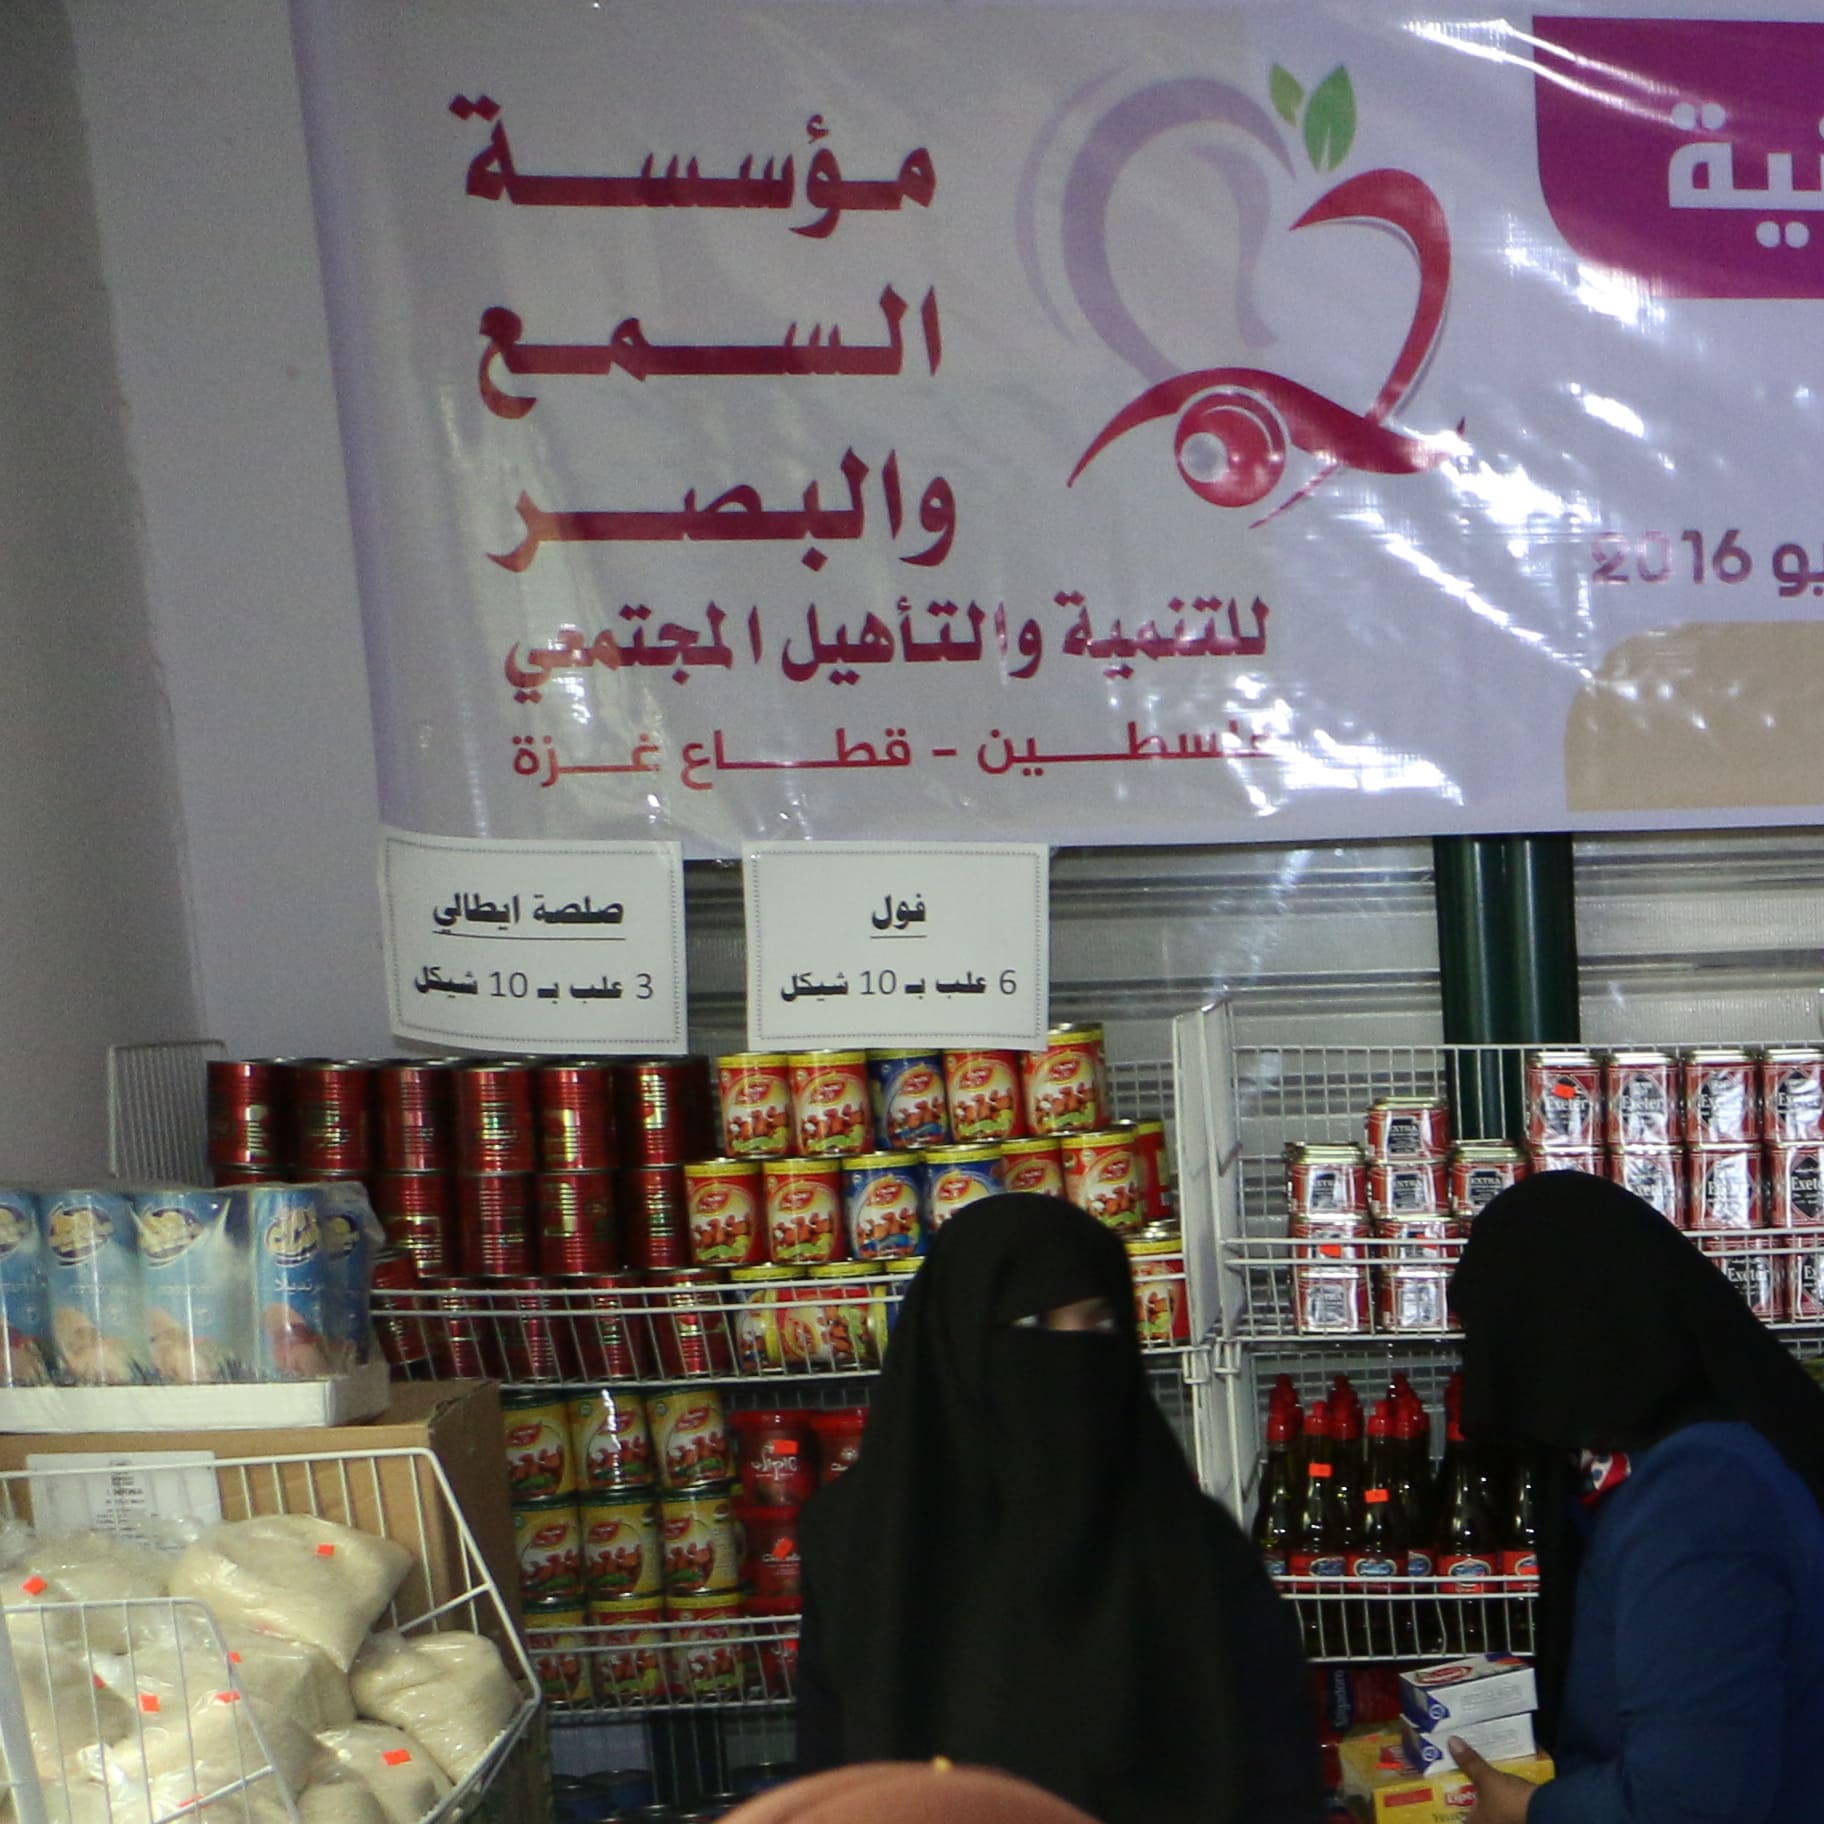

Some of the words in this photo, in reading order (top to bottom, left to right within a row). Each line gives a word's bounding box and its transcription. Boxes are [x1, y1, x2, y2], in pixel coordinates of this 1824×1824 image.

[446, 92, 938, 240] مؤسسة
[478, 284, 943, 419] السمع
[485, 448, 959, 571] والبصر
[1592, 529, 1752, 588] 2016
[502, 605, 763, 704] المجتمعي
[780, 596, 1044, 684] والتأهيل
[1061, 590, 1272, 679] للتنمية
[510, 726, 662, 788] غزة
[679, 726, 912, 790] قطاع
[432, 891, 520, 935] ايطالي
[532, 893, 625, 926] صلصة
[871, 892, 927, 931] فول
[414, 965, 479, 999] شيكل
[488, 970, 529, 999] 10
[570, 975, 624, 1004] علب
[635, 972, 655, 1001] 3
[780, 971, 849, 1003] شيكل
[859, 969, 898, 996] 10
[935, 970, 988, 1000] علب
[999, 968, 1018, 996] 6
